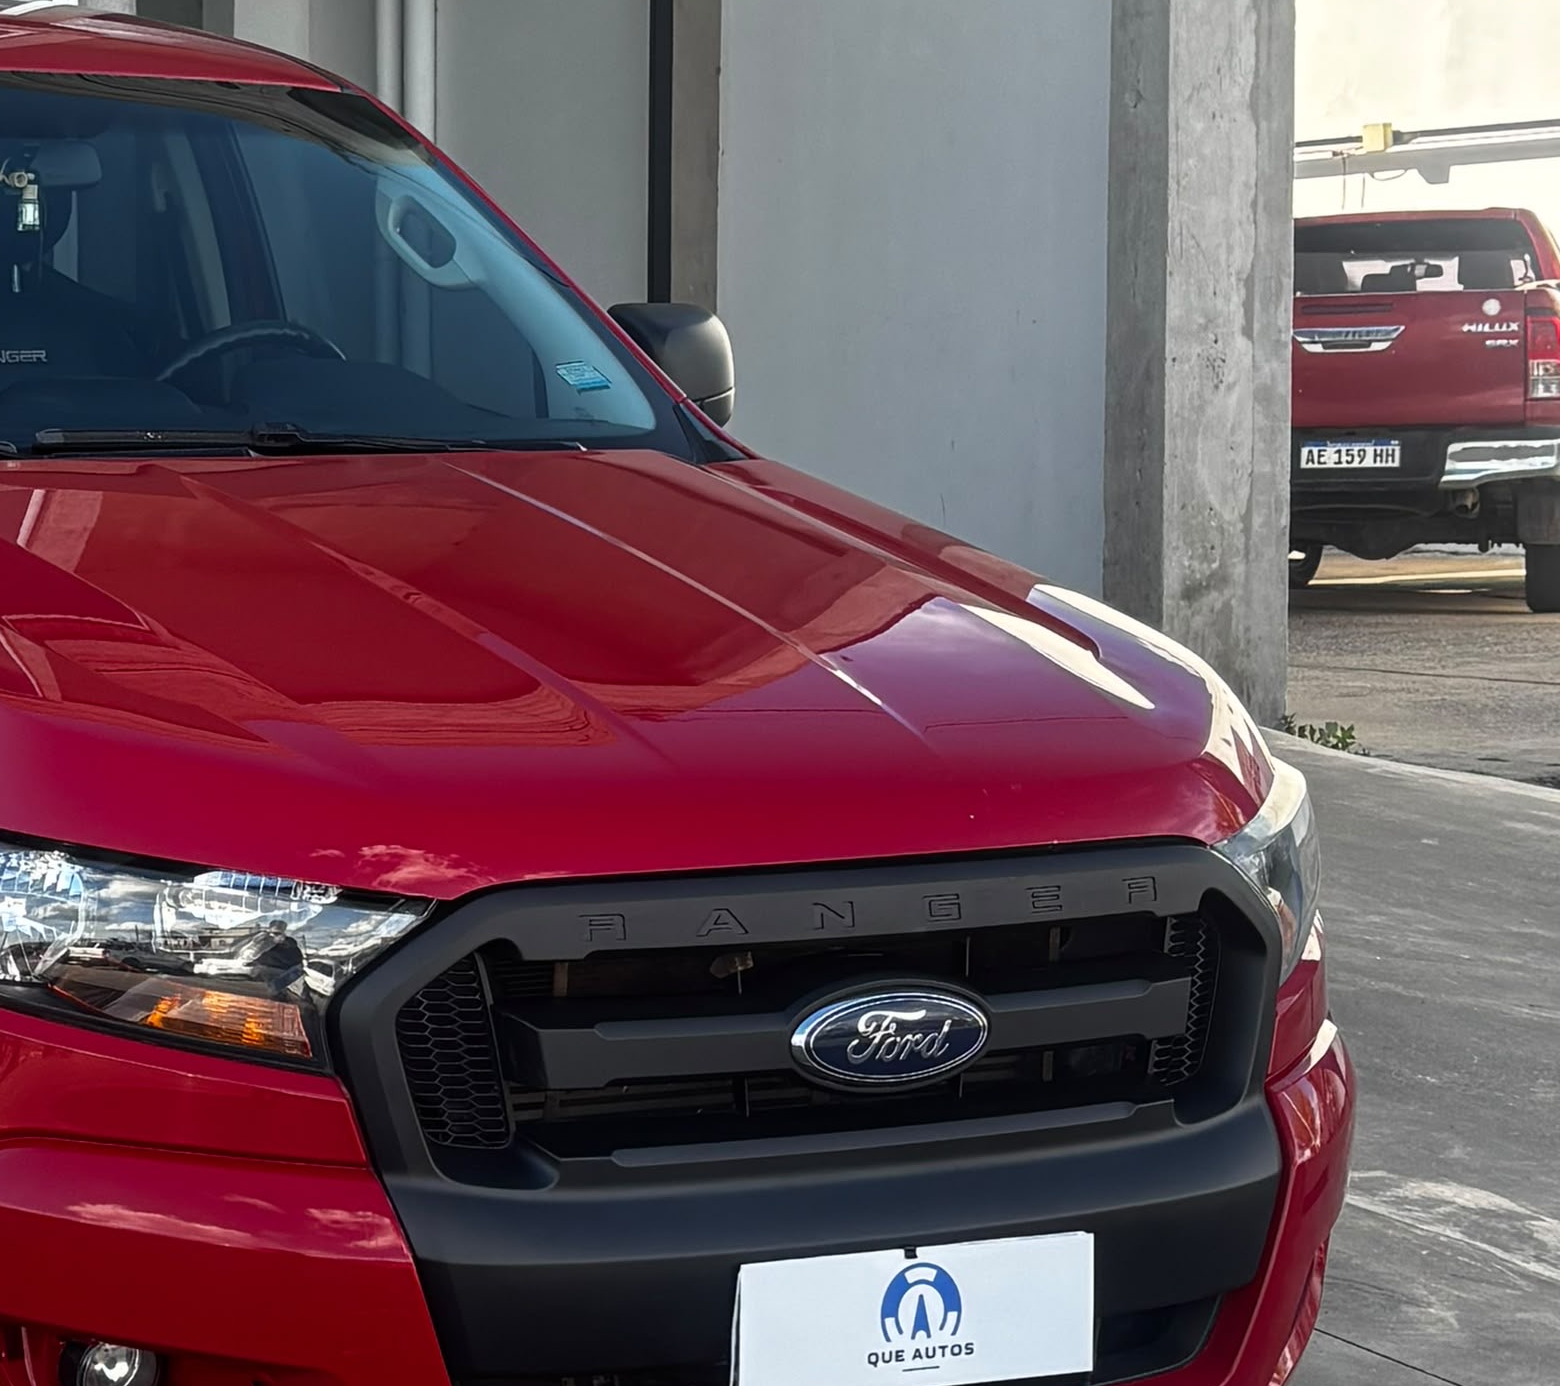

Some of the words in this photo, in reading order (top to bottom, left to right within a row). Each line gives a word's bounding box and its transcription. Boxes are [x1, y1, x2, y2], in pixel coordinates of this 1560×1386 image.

[1462, 322, 1520, 332] HILUX
[1305, 449, 1327, 465] AE
[1333, 449, 1366, 465] 159
[1373, 448, 1395, 464] HH
[579, 876, 1158, 942] RANGER
[847, 1008, 952, 1062] Ford
[867, 1349, 905, 1367] QUE
[912, 1342, 975, 1361] AUTOS
